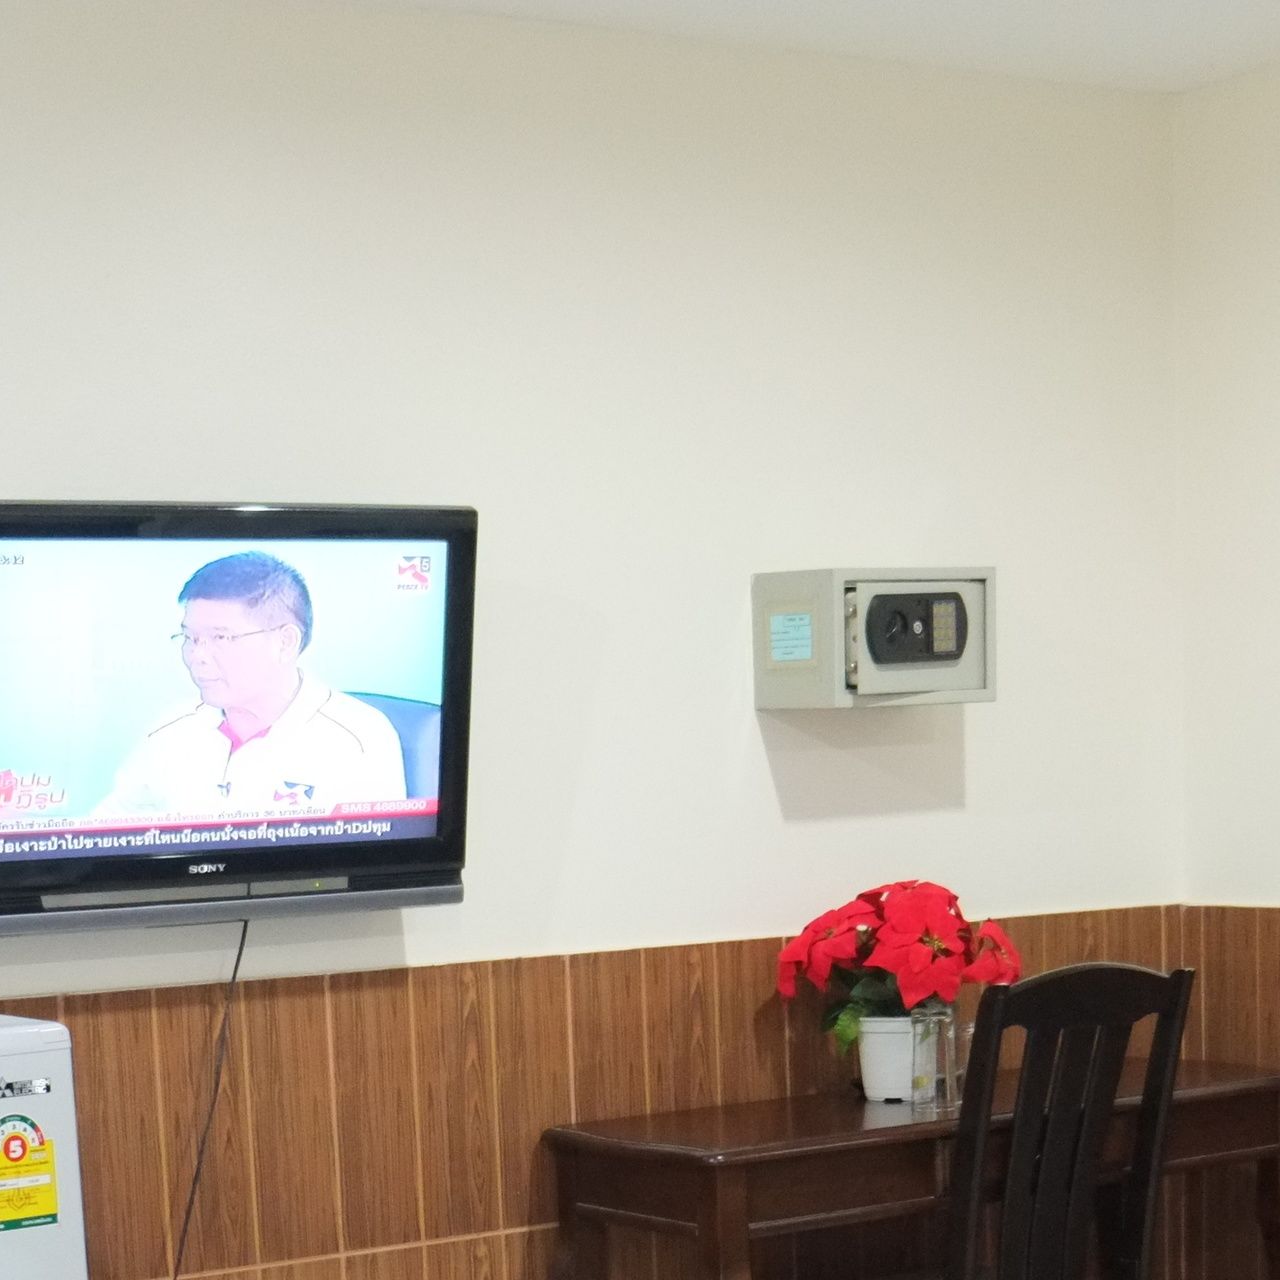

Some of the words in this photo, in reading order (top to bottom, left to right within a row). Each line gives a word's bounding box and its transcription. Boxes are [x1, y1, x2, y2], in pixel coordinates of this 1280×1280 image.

[341, 803, 373, 814] SMS
[188, 863, 228, 874] SONY
[9, 1140, 24, 1159] 5
